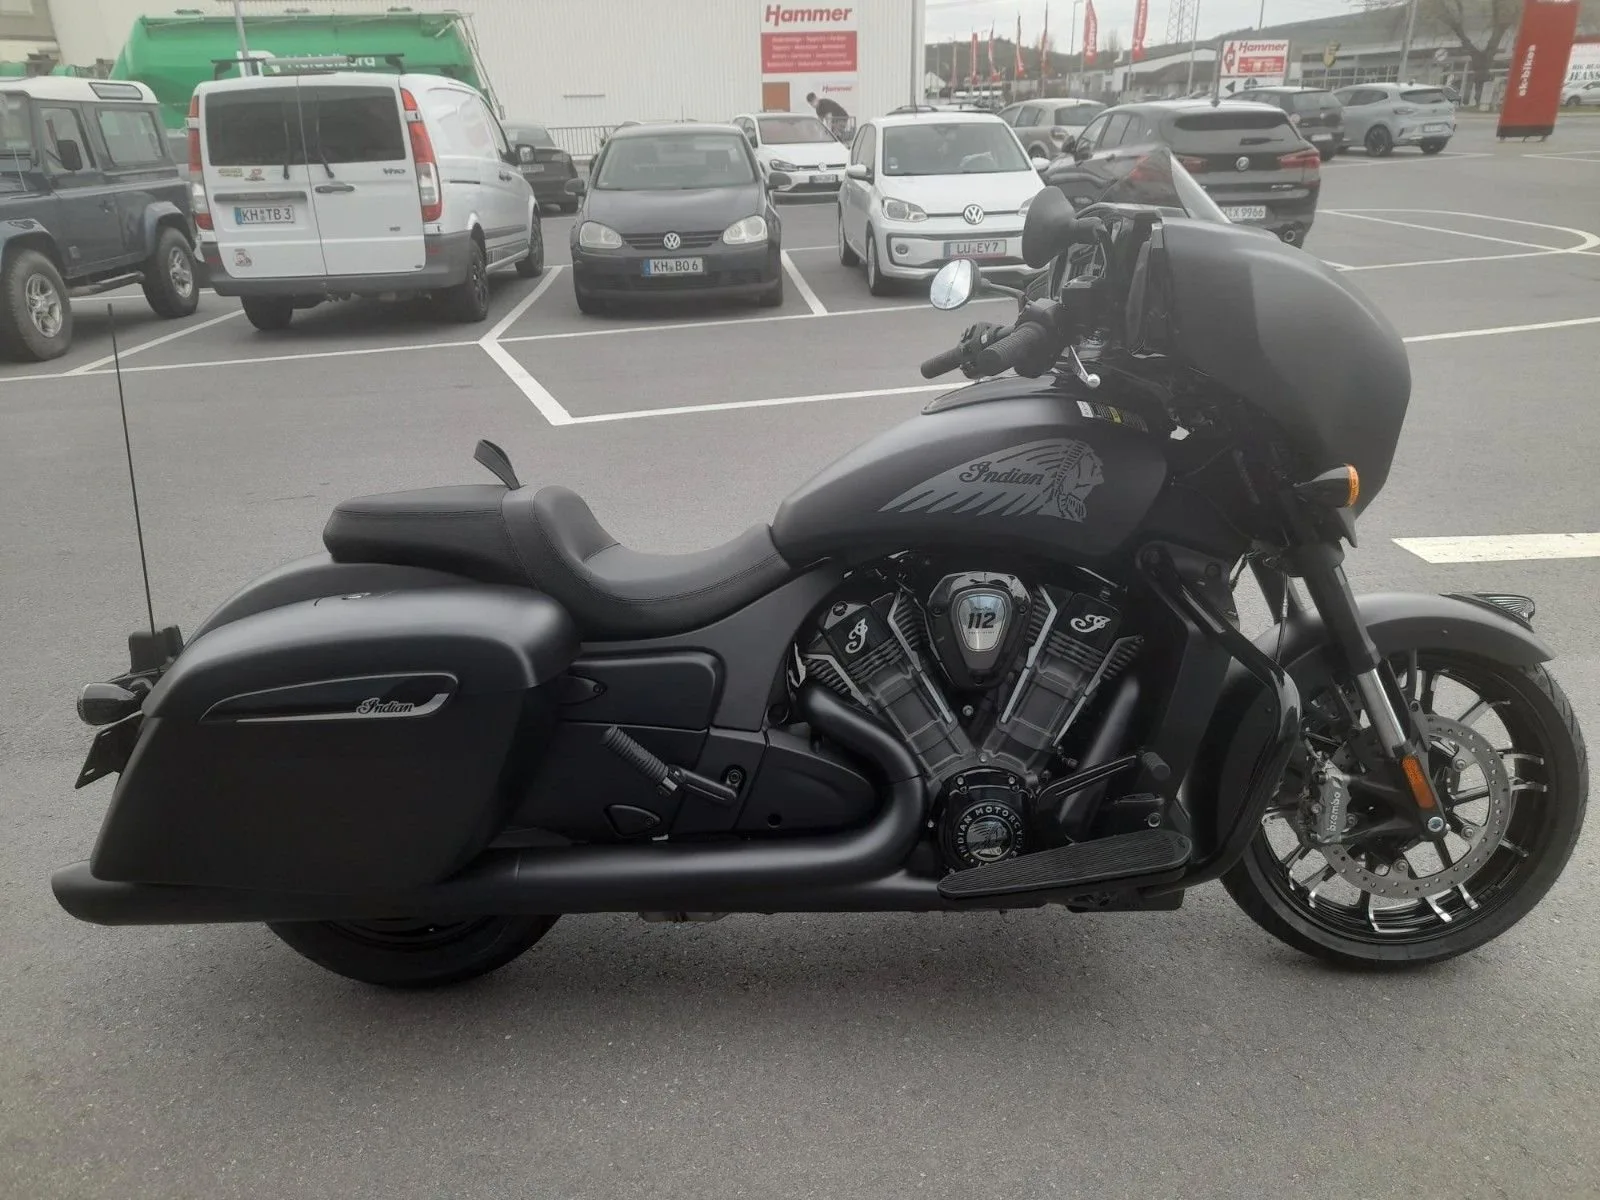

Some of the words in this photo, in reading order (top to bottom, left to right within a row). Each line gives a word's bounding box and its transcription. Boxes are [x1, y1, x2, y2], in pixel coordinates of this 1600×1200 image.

[765, 4, 853, 26] Hammer
[1239, 41, 1287, 53] Hammer
[822, 85, 853, 94] Hammer
[242, 209, 259, 222] KH
[265, 208, 282, 220] TB
[283, 207, 292, 220] 3
[957, 243, 971, 254] LU
[977, 241, 990, 254] EY
[653, 260, 668, 272] KH
[675, 260, 690, 272] BO
[692, 259, 699, 271] 6
[959, 460, 1045, 486] Indian
[968, 612, 996, 629] 112
[357, 697, 414, 714] Indian
[1326, 791, 1341, 832] brembo
[957, 815, 973, 858] INDIAN
